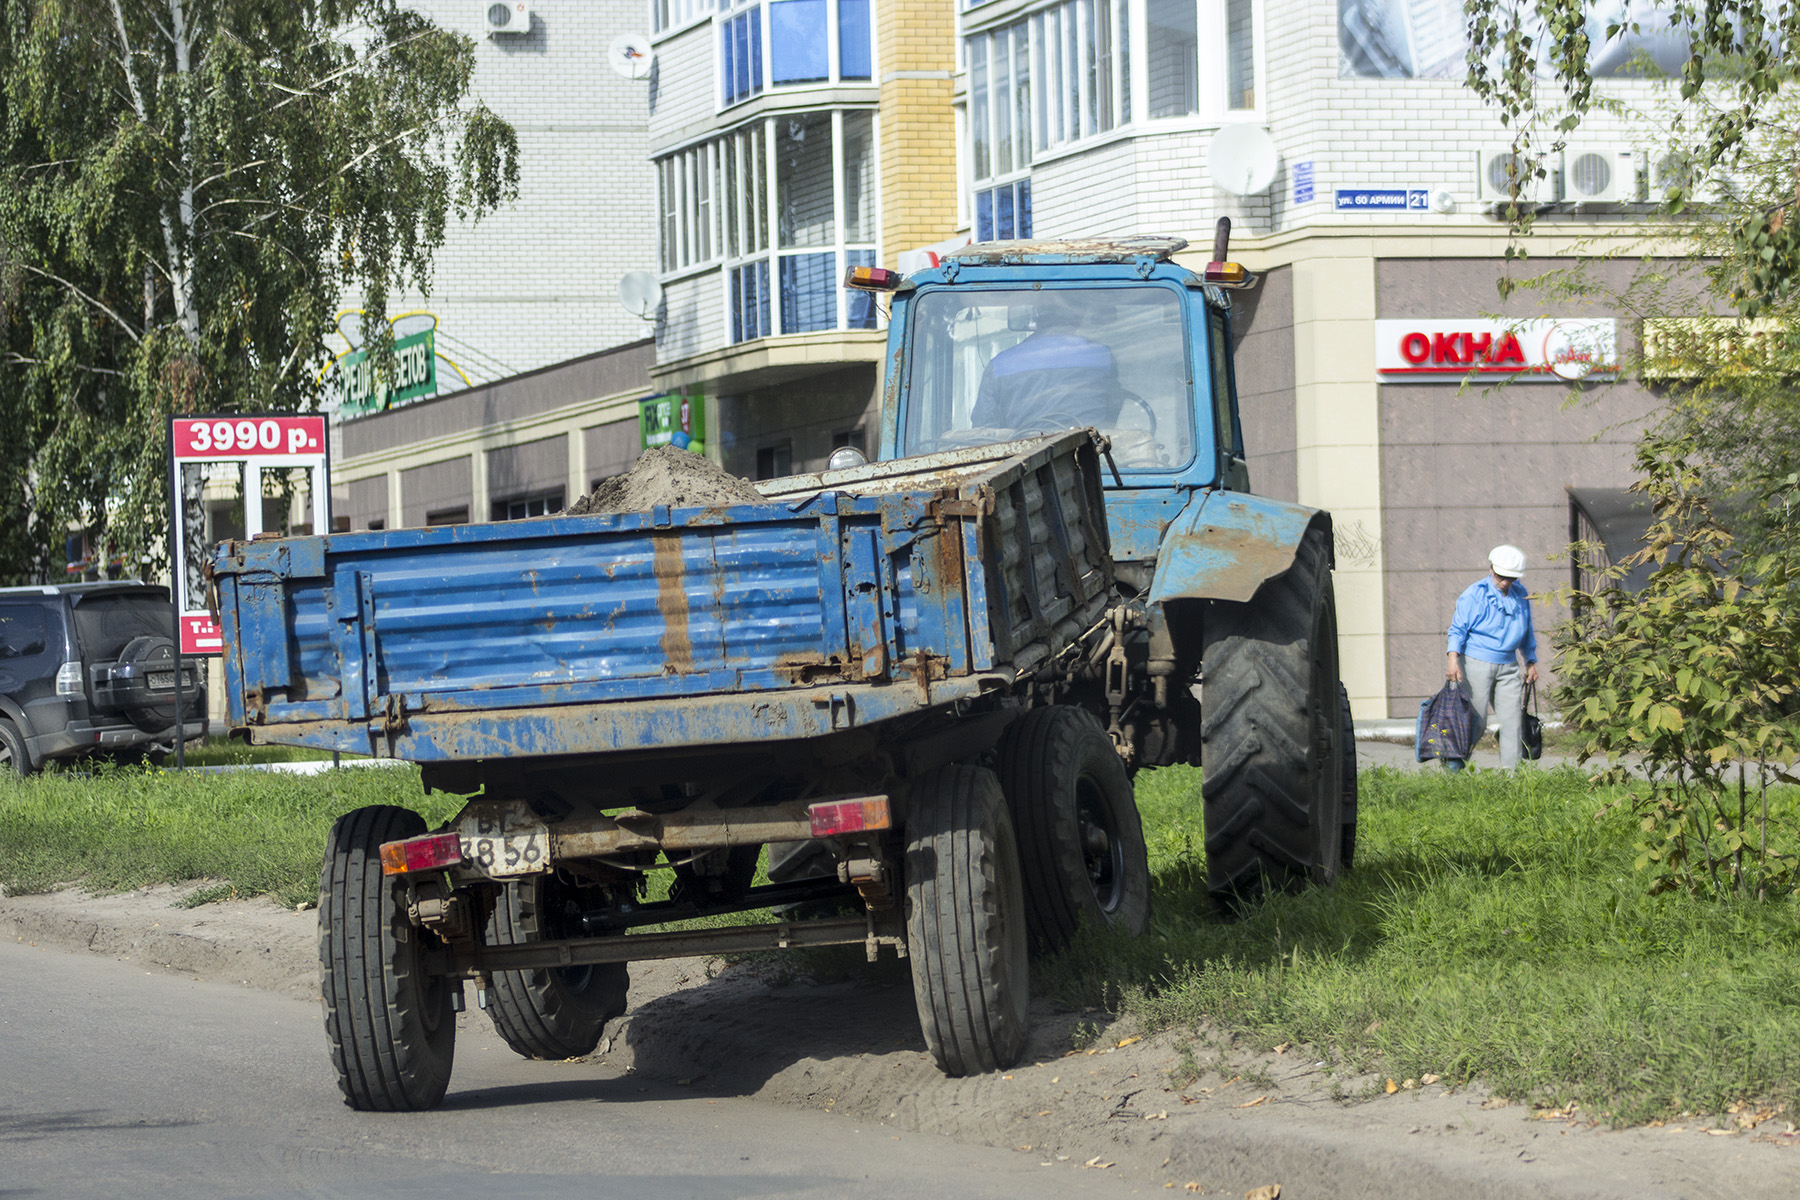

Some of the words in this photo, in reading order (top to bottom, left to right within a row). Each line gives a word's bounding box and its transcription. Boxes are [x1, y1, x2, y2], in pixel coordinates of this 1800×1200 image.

[1337, 197, 1353, 207] ул.
[1355, 197, 1368, 205] 60
[1369, 197, 1405, 206] АРМИИ
[1410, 194, 1428, 207] 21
[1399, 331, 1526, 364] ОКНА
[388, 343, 427, 396] ВЕТОВ
[190, 420, 281, 451] 3990
[287, 428, 317, 454] р.
